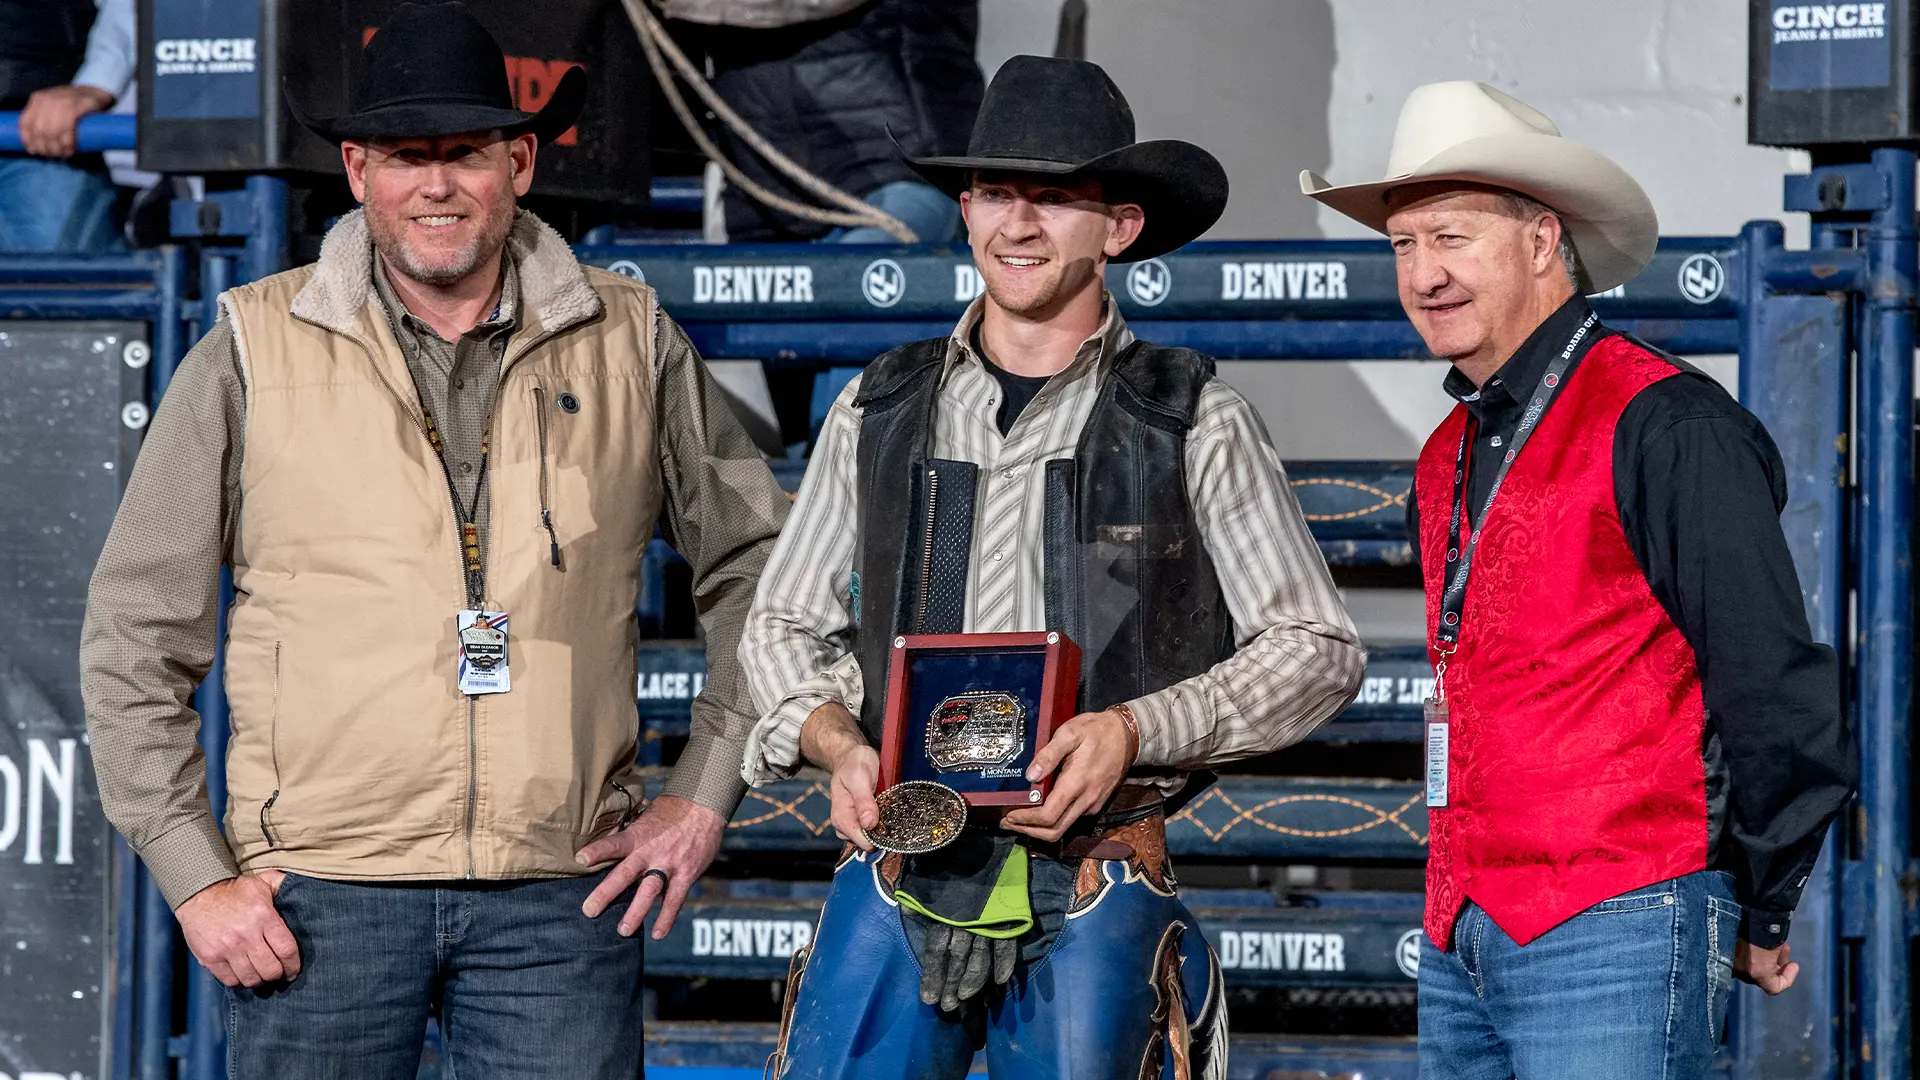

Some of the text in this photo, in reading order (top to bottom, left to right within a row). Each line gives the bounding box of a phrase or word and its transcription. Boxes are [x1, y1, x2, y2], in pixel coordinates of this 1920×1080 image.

[1772, 3, 1885, 30] CINCH
[155, 38, 256, 61] CINCH
[1774, 29, 1818, 44] JEANS
[1818, 29, 1832, 41] &
[692, 265, 815, 303] DENVER
[1221, 261, 1349, 300] DENVER
[1561, 327, 1587, 360] BOARD
[692, 918, 813, 957] DENVER
[1219, 930, 1346, 972] DENVER
